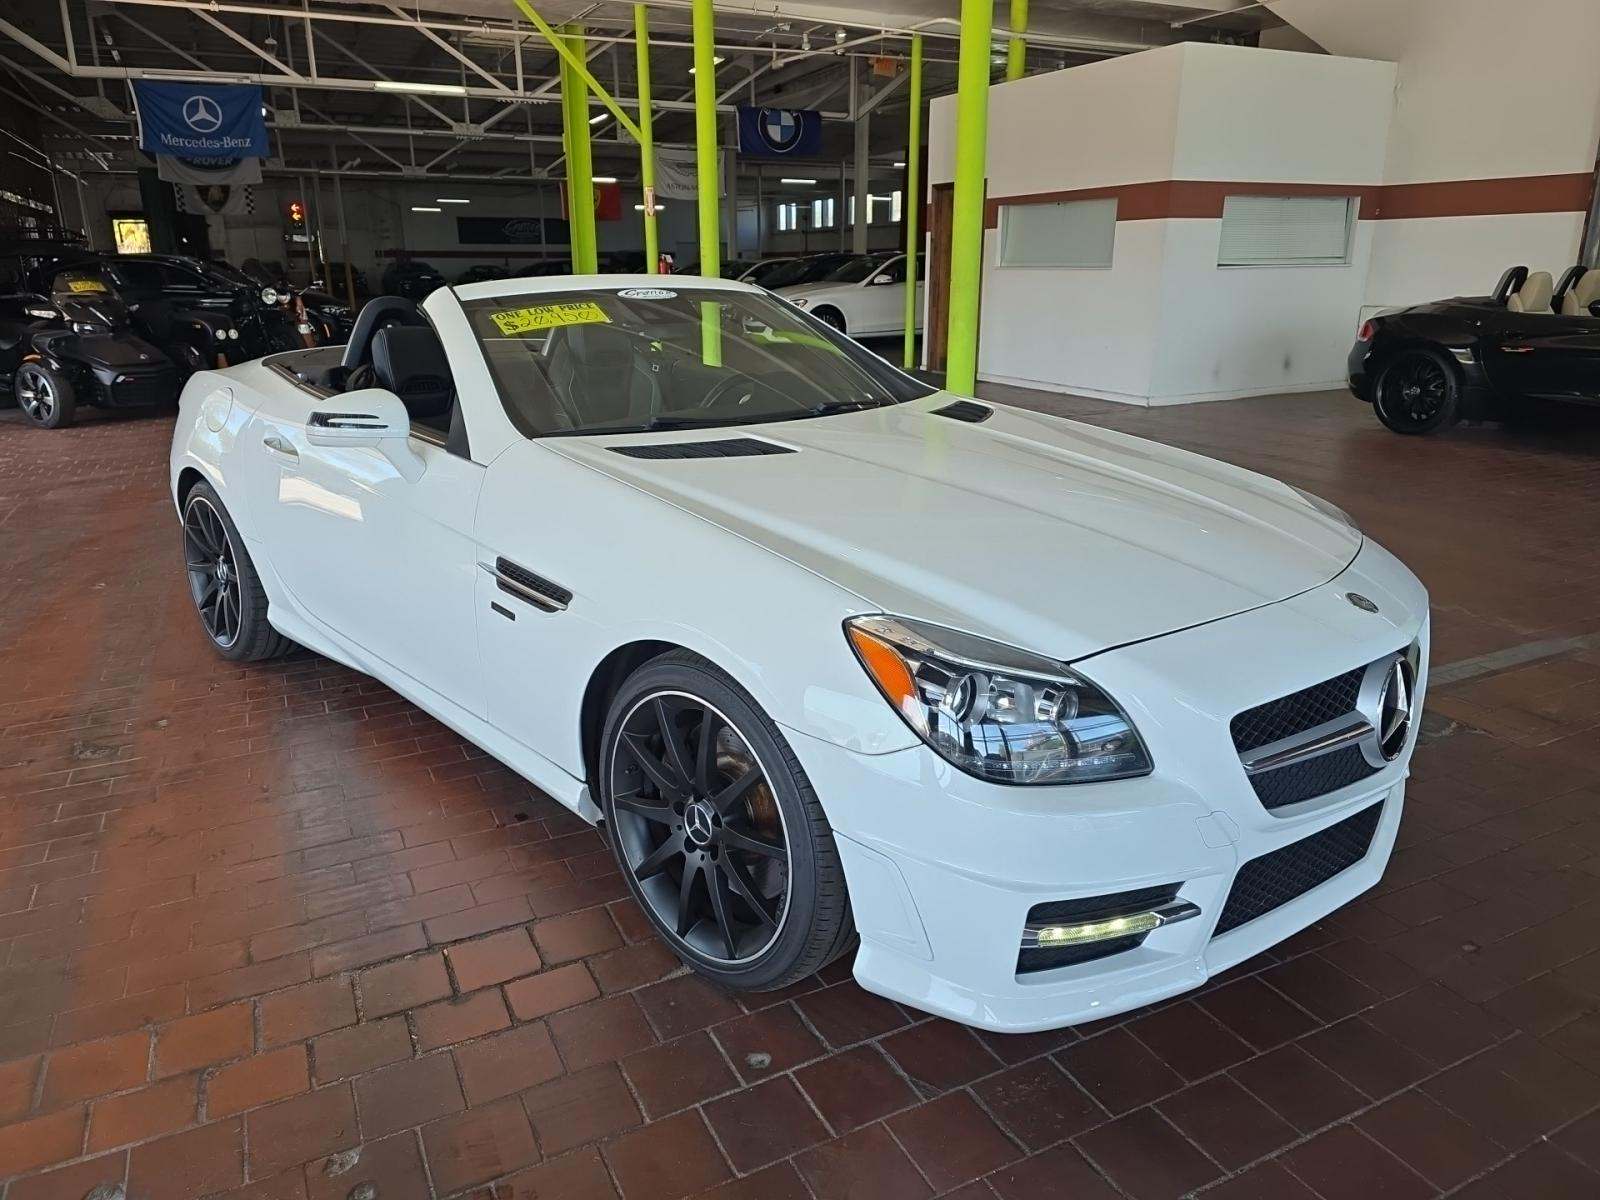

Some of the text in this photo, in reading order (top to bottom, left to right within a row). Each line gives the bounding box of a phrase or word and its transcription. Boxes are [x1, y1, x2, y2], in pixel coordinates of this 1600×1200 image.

[161, 133, 252, 148] Mercedes-Benz
[193, 157, 233, 166] ROVER
[496, 302, 595, 321] ONE LOW PRICE
